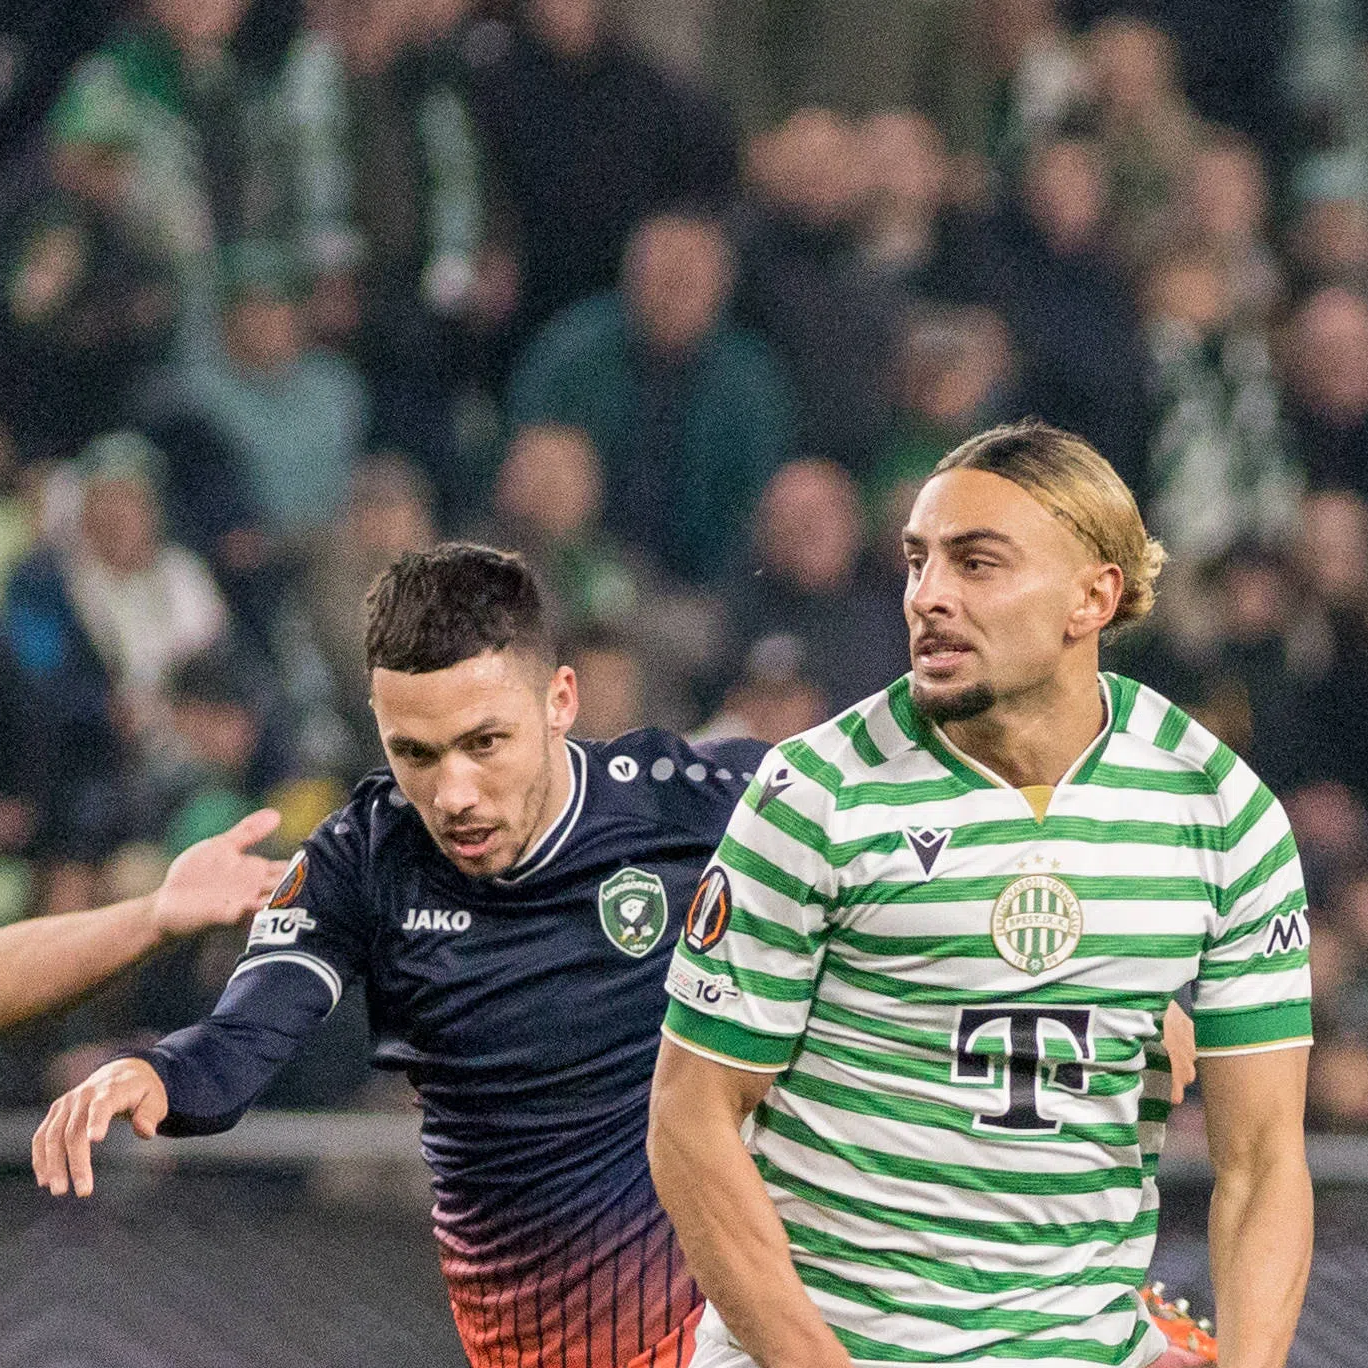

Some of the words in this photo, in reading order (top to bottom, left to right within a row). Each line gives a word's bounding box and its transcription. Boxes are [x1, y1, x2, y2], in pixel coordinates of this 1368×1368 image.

[402, 908, 471, 931] JAKO
[696, 979, 721, 1003] 10
[957, 1008, 1091, 1130] T
